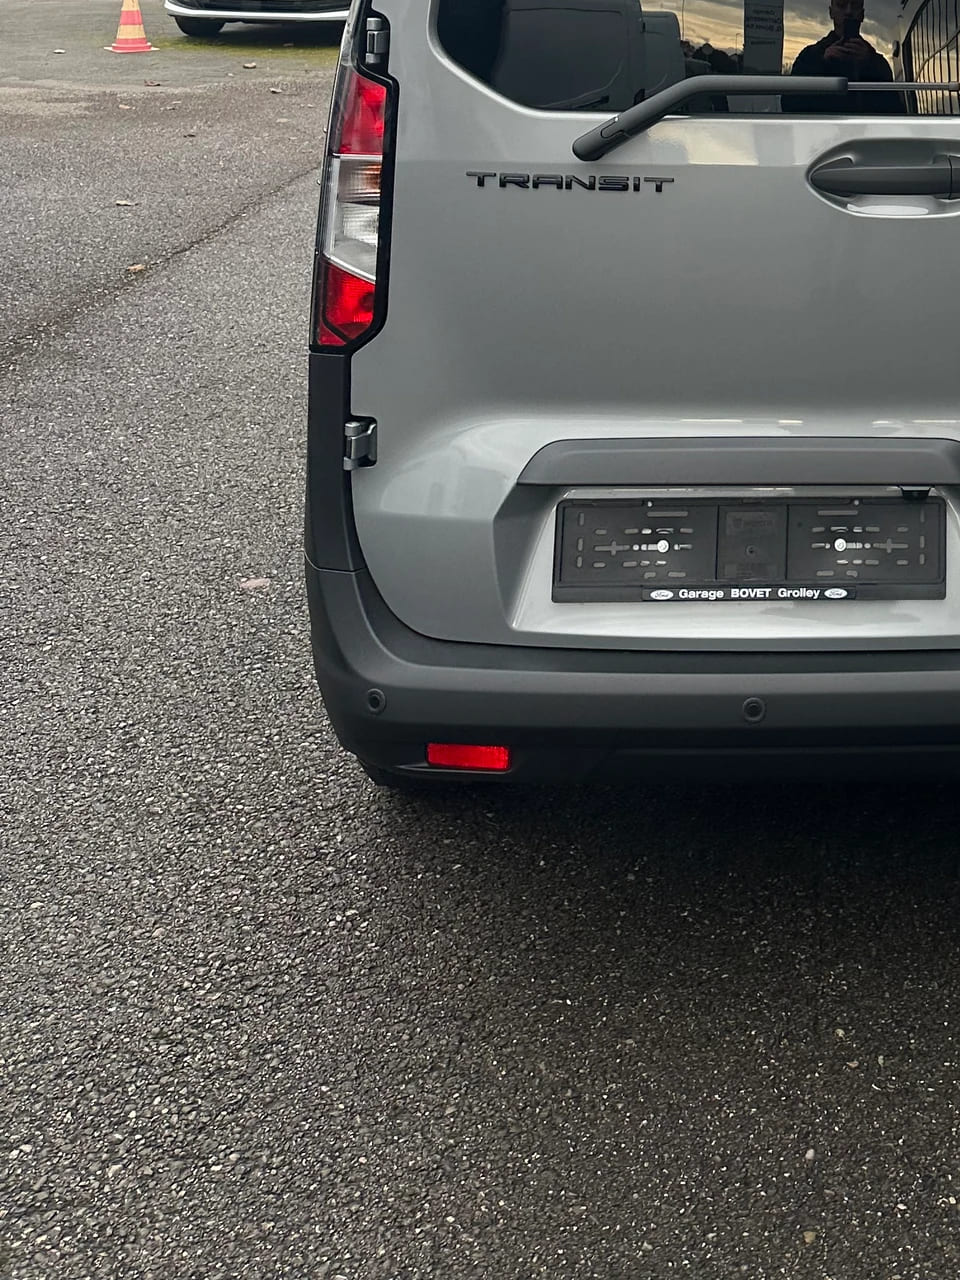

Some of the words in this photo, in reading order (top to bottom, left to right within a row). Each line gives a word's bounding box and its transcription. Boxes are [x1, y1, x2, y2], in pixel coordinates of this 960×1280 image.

[466, 171, 675, 193] TRANSIT
[678, 588, 725, 600] Garage
[730, 588, 772, 598] BOVET
[777, 587, 820, 599] Grolley
